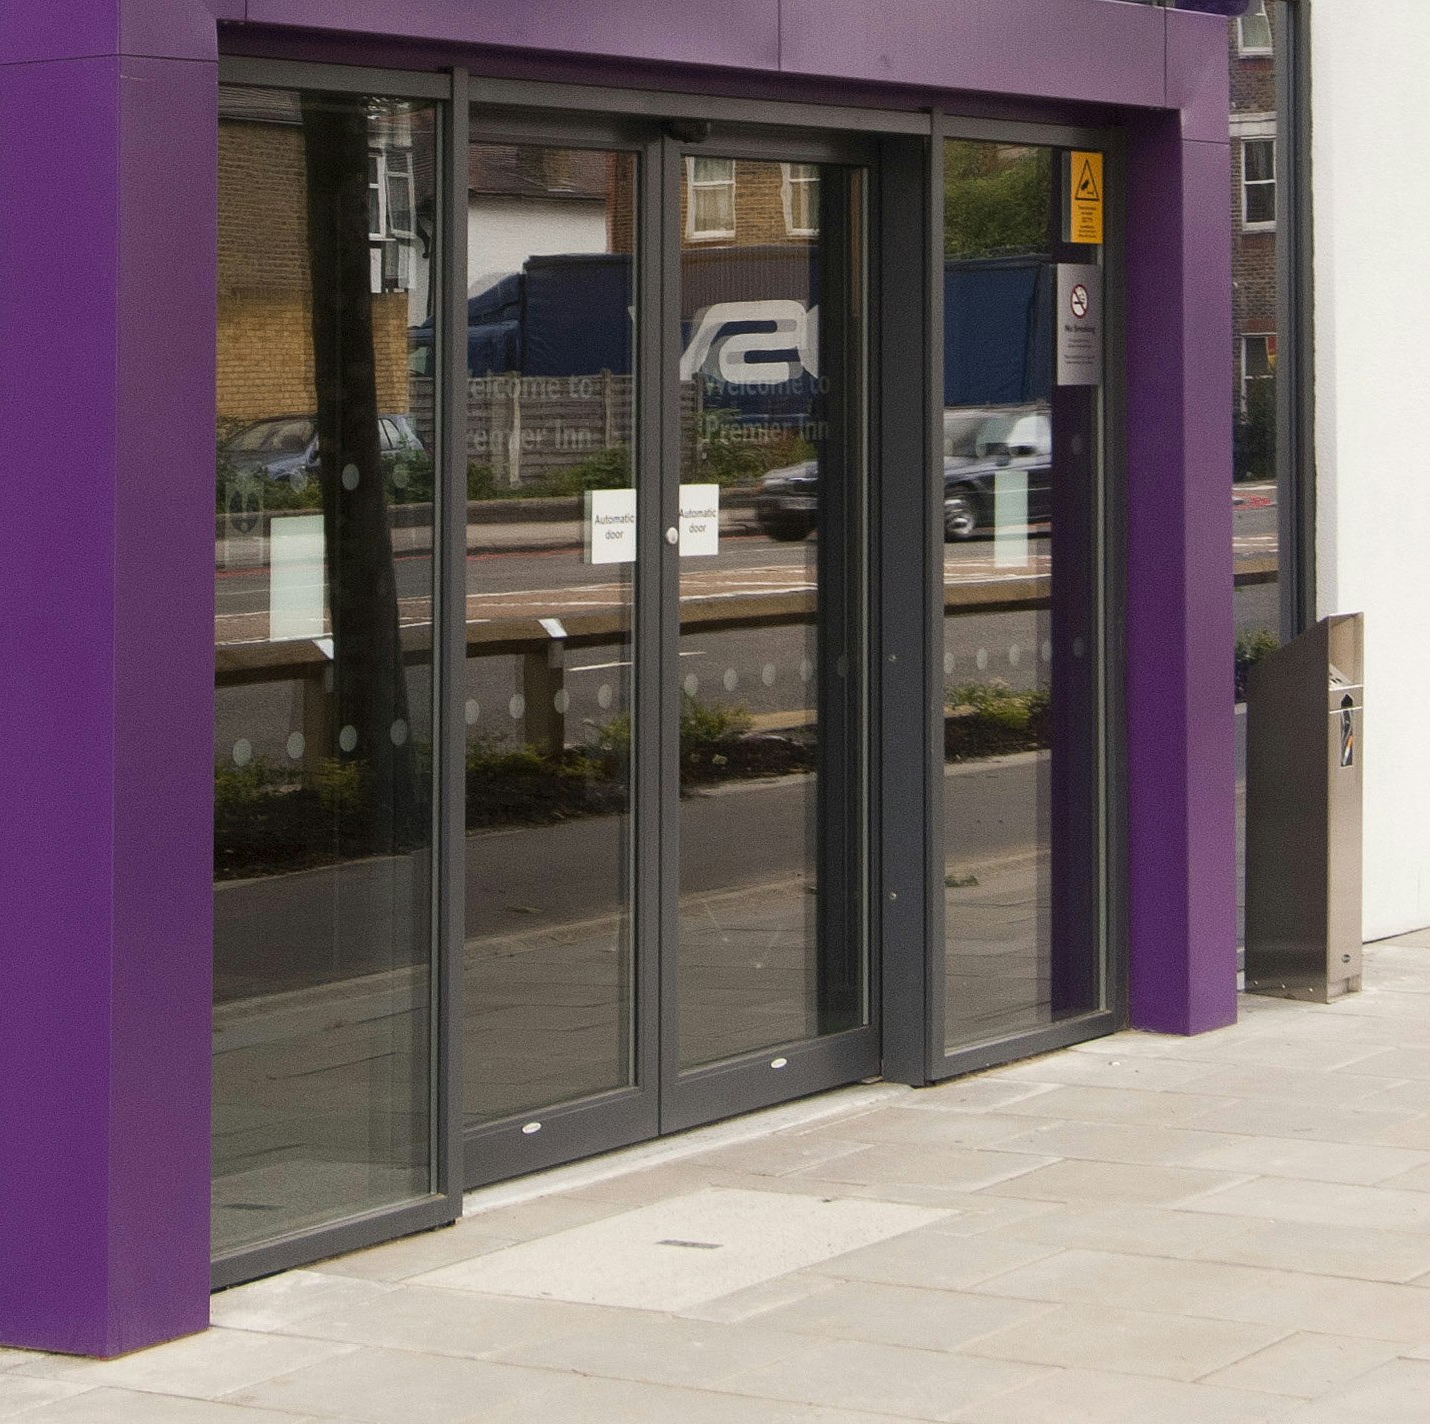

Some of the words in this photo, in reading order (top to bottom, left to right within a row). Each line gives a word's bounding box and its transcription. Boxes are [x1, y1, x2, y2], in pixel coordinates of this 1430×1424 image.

[680, 508, 717, 519] Automatic
[594, 514, 635, 525] Automatic
[689, 523, 707, 533] door
[604, 530, 624, 540] door
